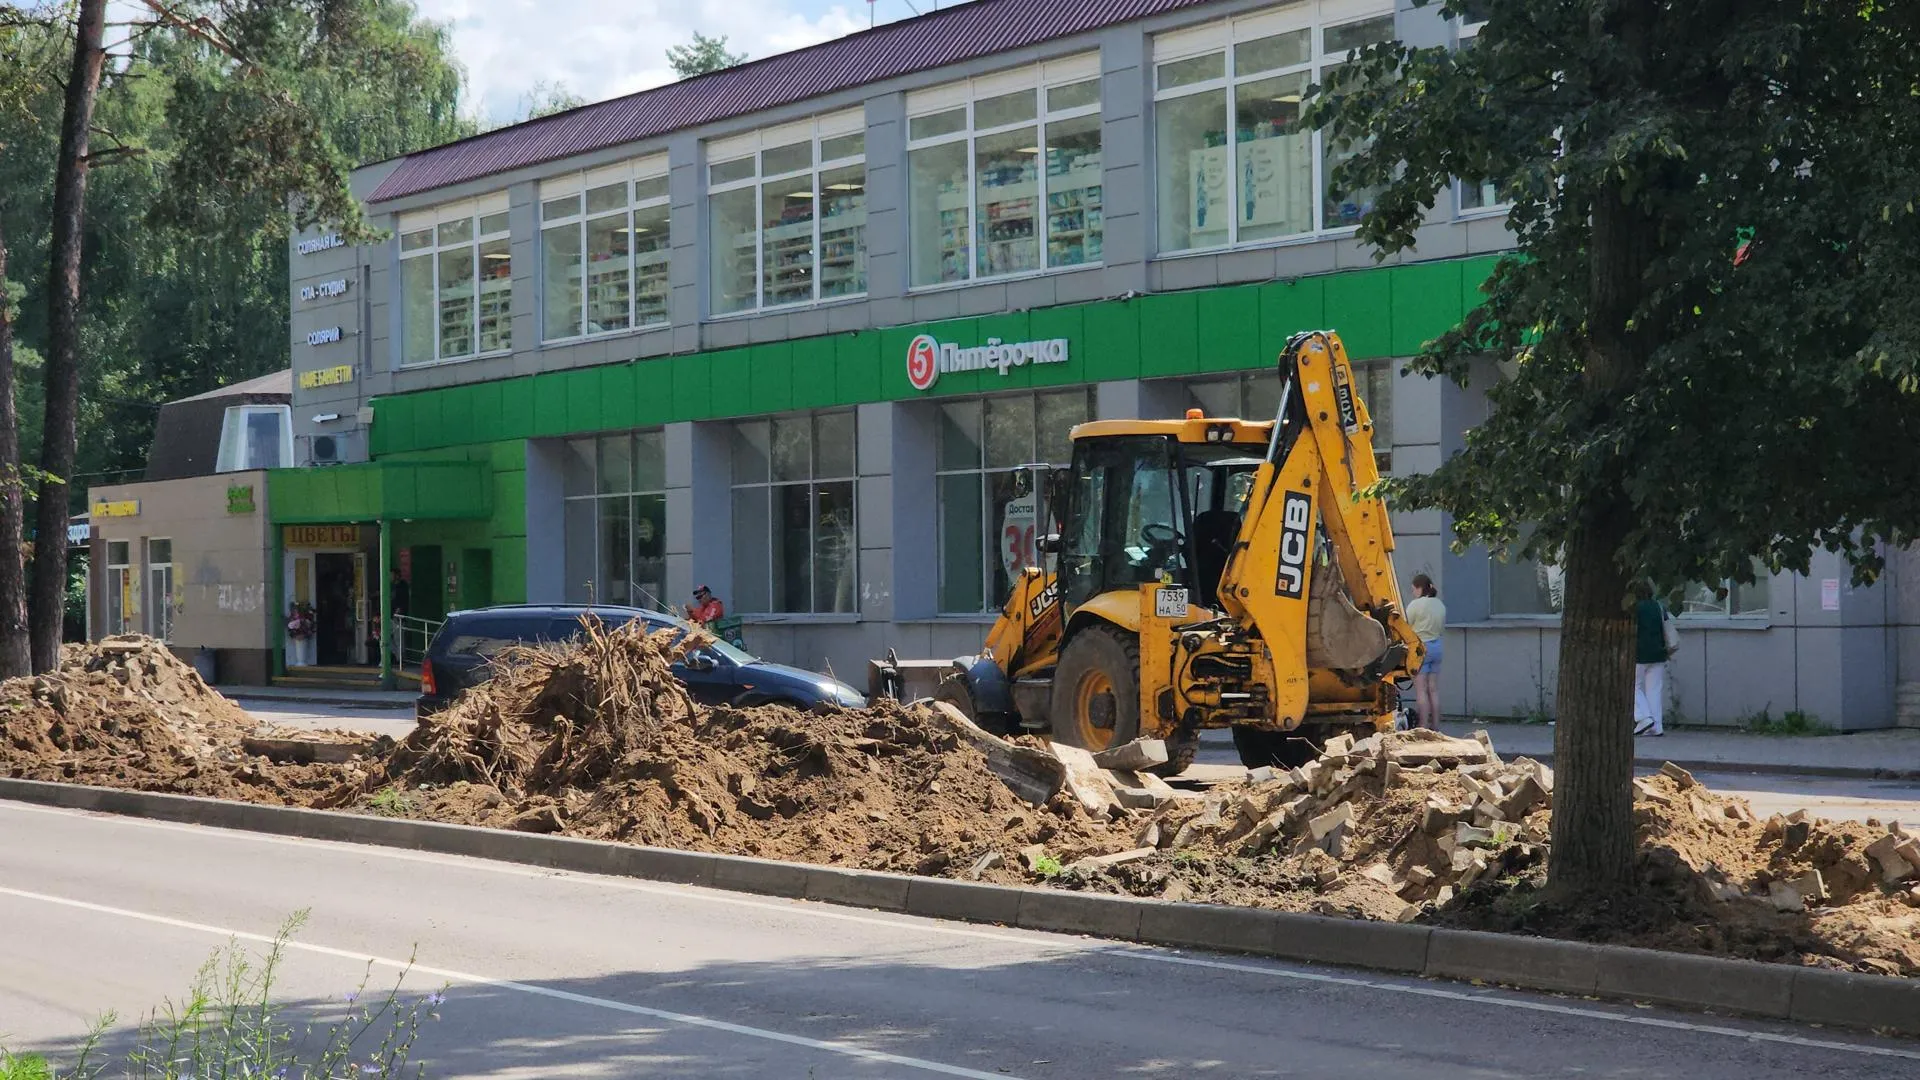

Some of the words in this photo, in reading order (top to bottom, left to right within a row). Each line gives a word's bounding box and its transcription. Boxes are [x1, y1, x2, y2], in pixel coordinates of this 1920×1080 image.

[940, 337, 1068, 376] Пятёрочка
[291, 526, 357, 543] ЦВЕТЫ
[1279, 498, 1309, 591] JCB
[1161, 591, 1184, 602] 7539
[1176, 603, 1186, 613] 50
